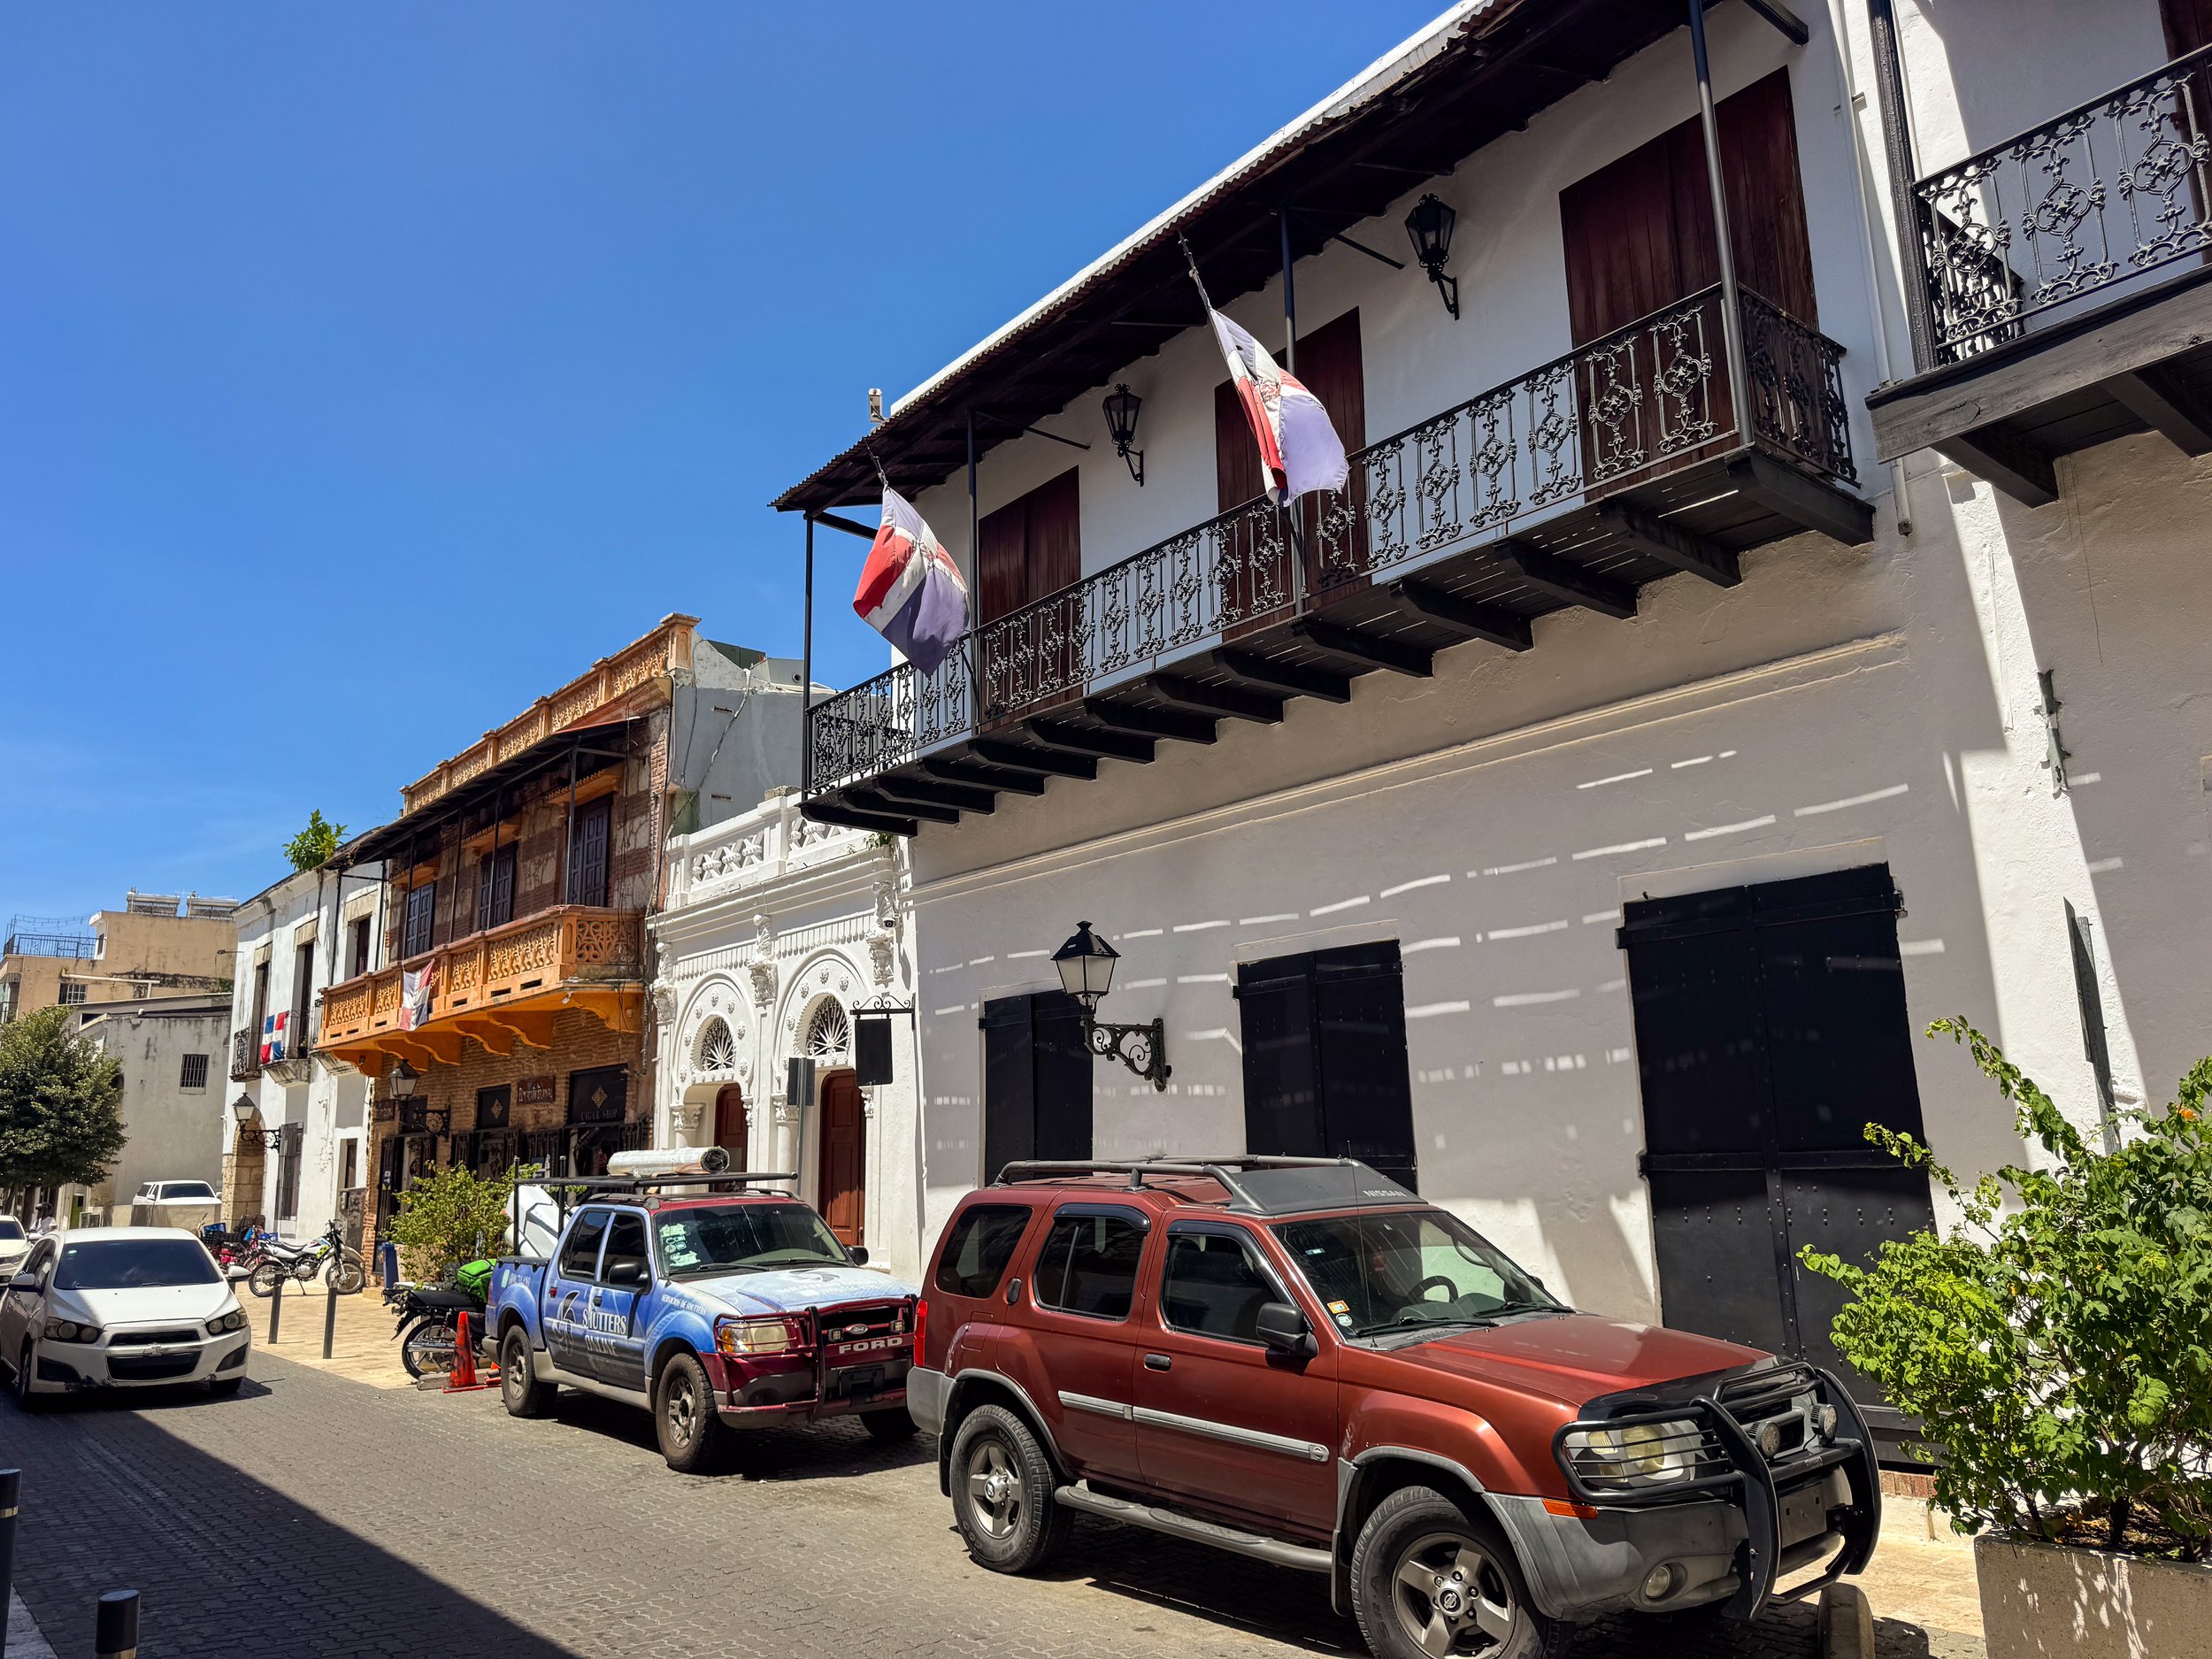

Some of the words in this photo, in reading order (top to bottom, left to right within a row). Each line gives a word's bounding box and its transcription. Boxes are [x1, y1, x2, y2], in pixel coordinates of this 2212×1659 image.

[580, 1110, 600, 1121] CIGAR
[602, 1108, 618, 1119] SHOP
[582, 1309, 626, 1334] SHUTTERS
[585, 1334, 618, 1356] ONLINE
[839, 1337, 902, 1355] FORD
